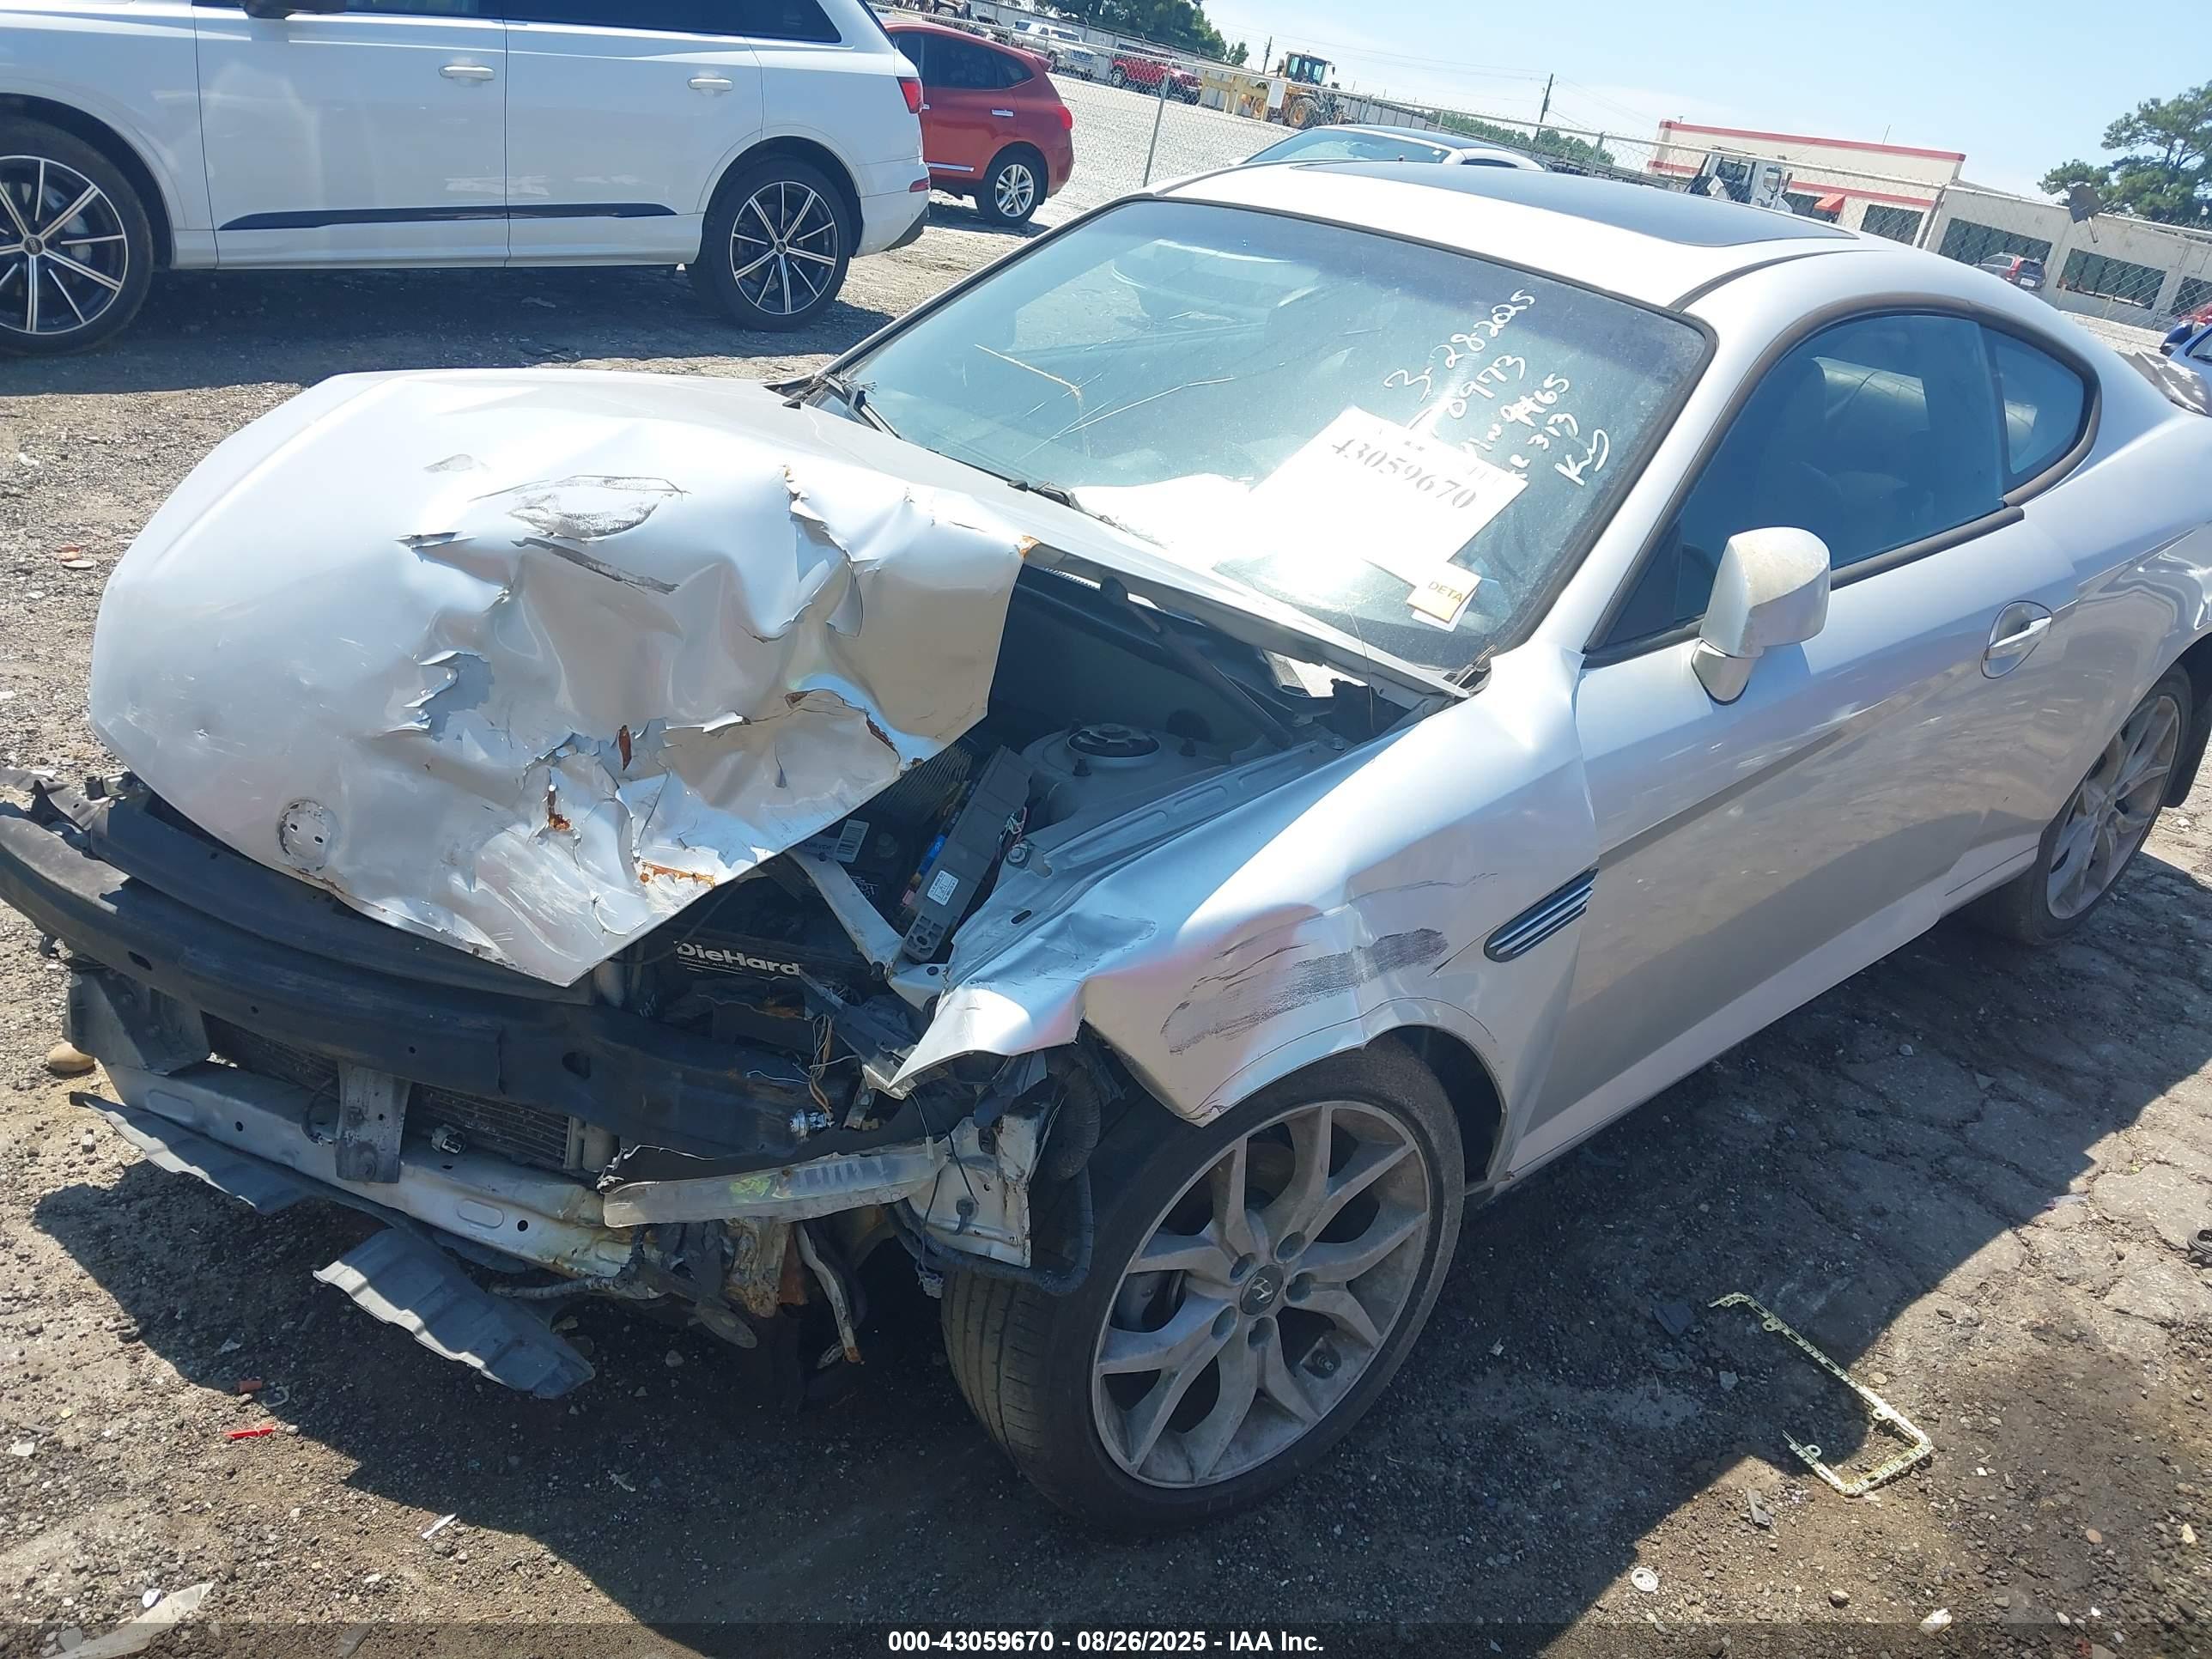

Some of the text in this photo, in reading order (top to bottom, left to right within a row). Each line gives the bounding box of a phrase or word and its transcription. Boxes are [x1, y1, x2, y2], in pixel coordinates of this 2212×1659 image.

[1448, 355, 1527, 419] 0973
[1331, 439, 1477, 508] 43059670
[673, 940, 800, 976] DieHard
